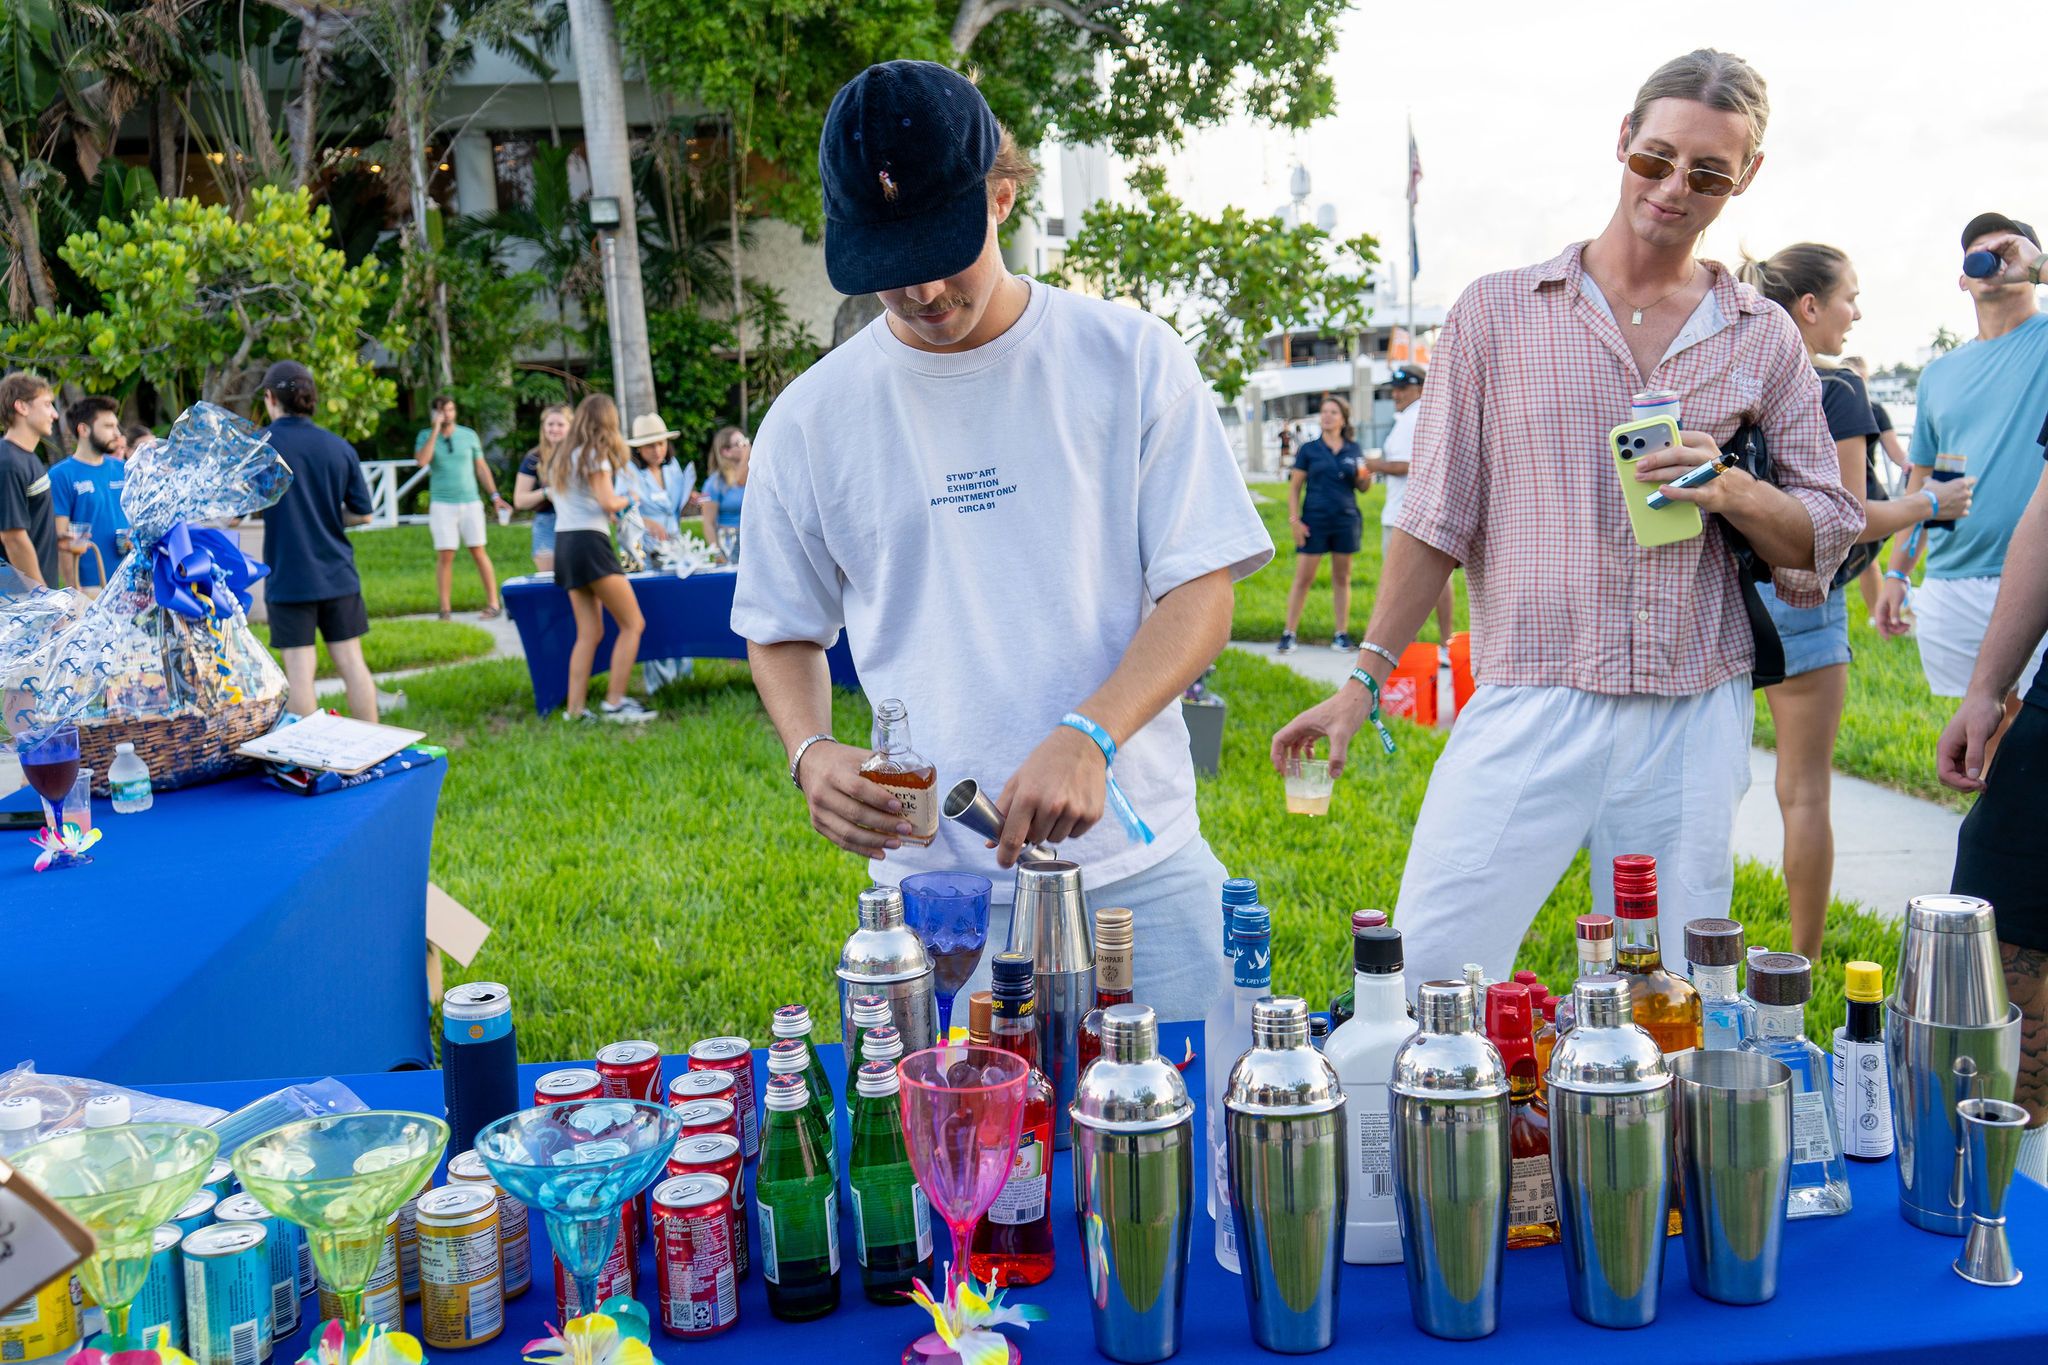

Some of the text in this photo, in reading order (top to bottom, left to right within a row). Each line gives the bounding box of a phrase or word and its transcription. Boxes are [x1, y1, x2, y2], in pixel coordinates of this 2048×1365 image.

[979, 467, 996, 478] ART
[947, 478, 999, 493] EXHIBITION
[930, 484, 1018, 506] APPOINTMENT ONLY
[958, 501, 996, 514] CIRCA 91
[901, 801, 918, 810] rk
[1098, 954, 1124, 963] CAMPARI
[733, 1220, 743, 1274] RECYCLE
